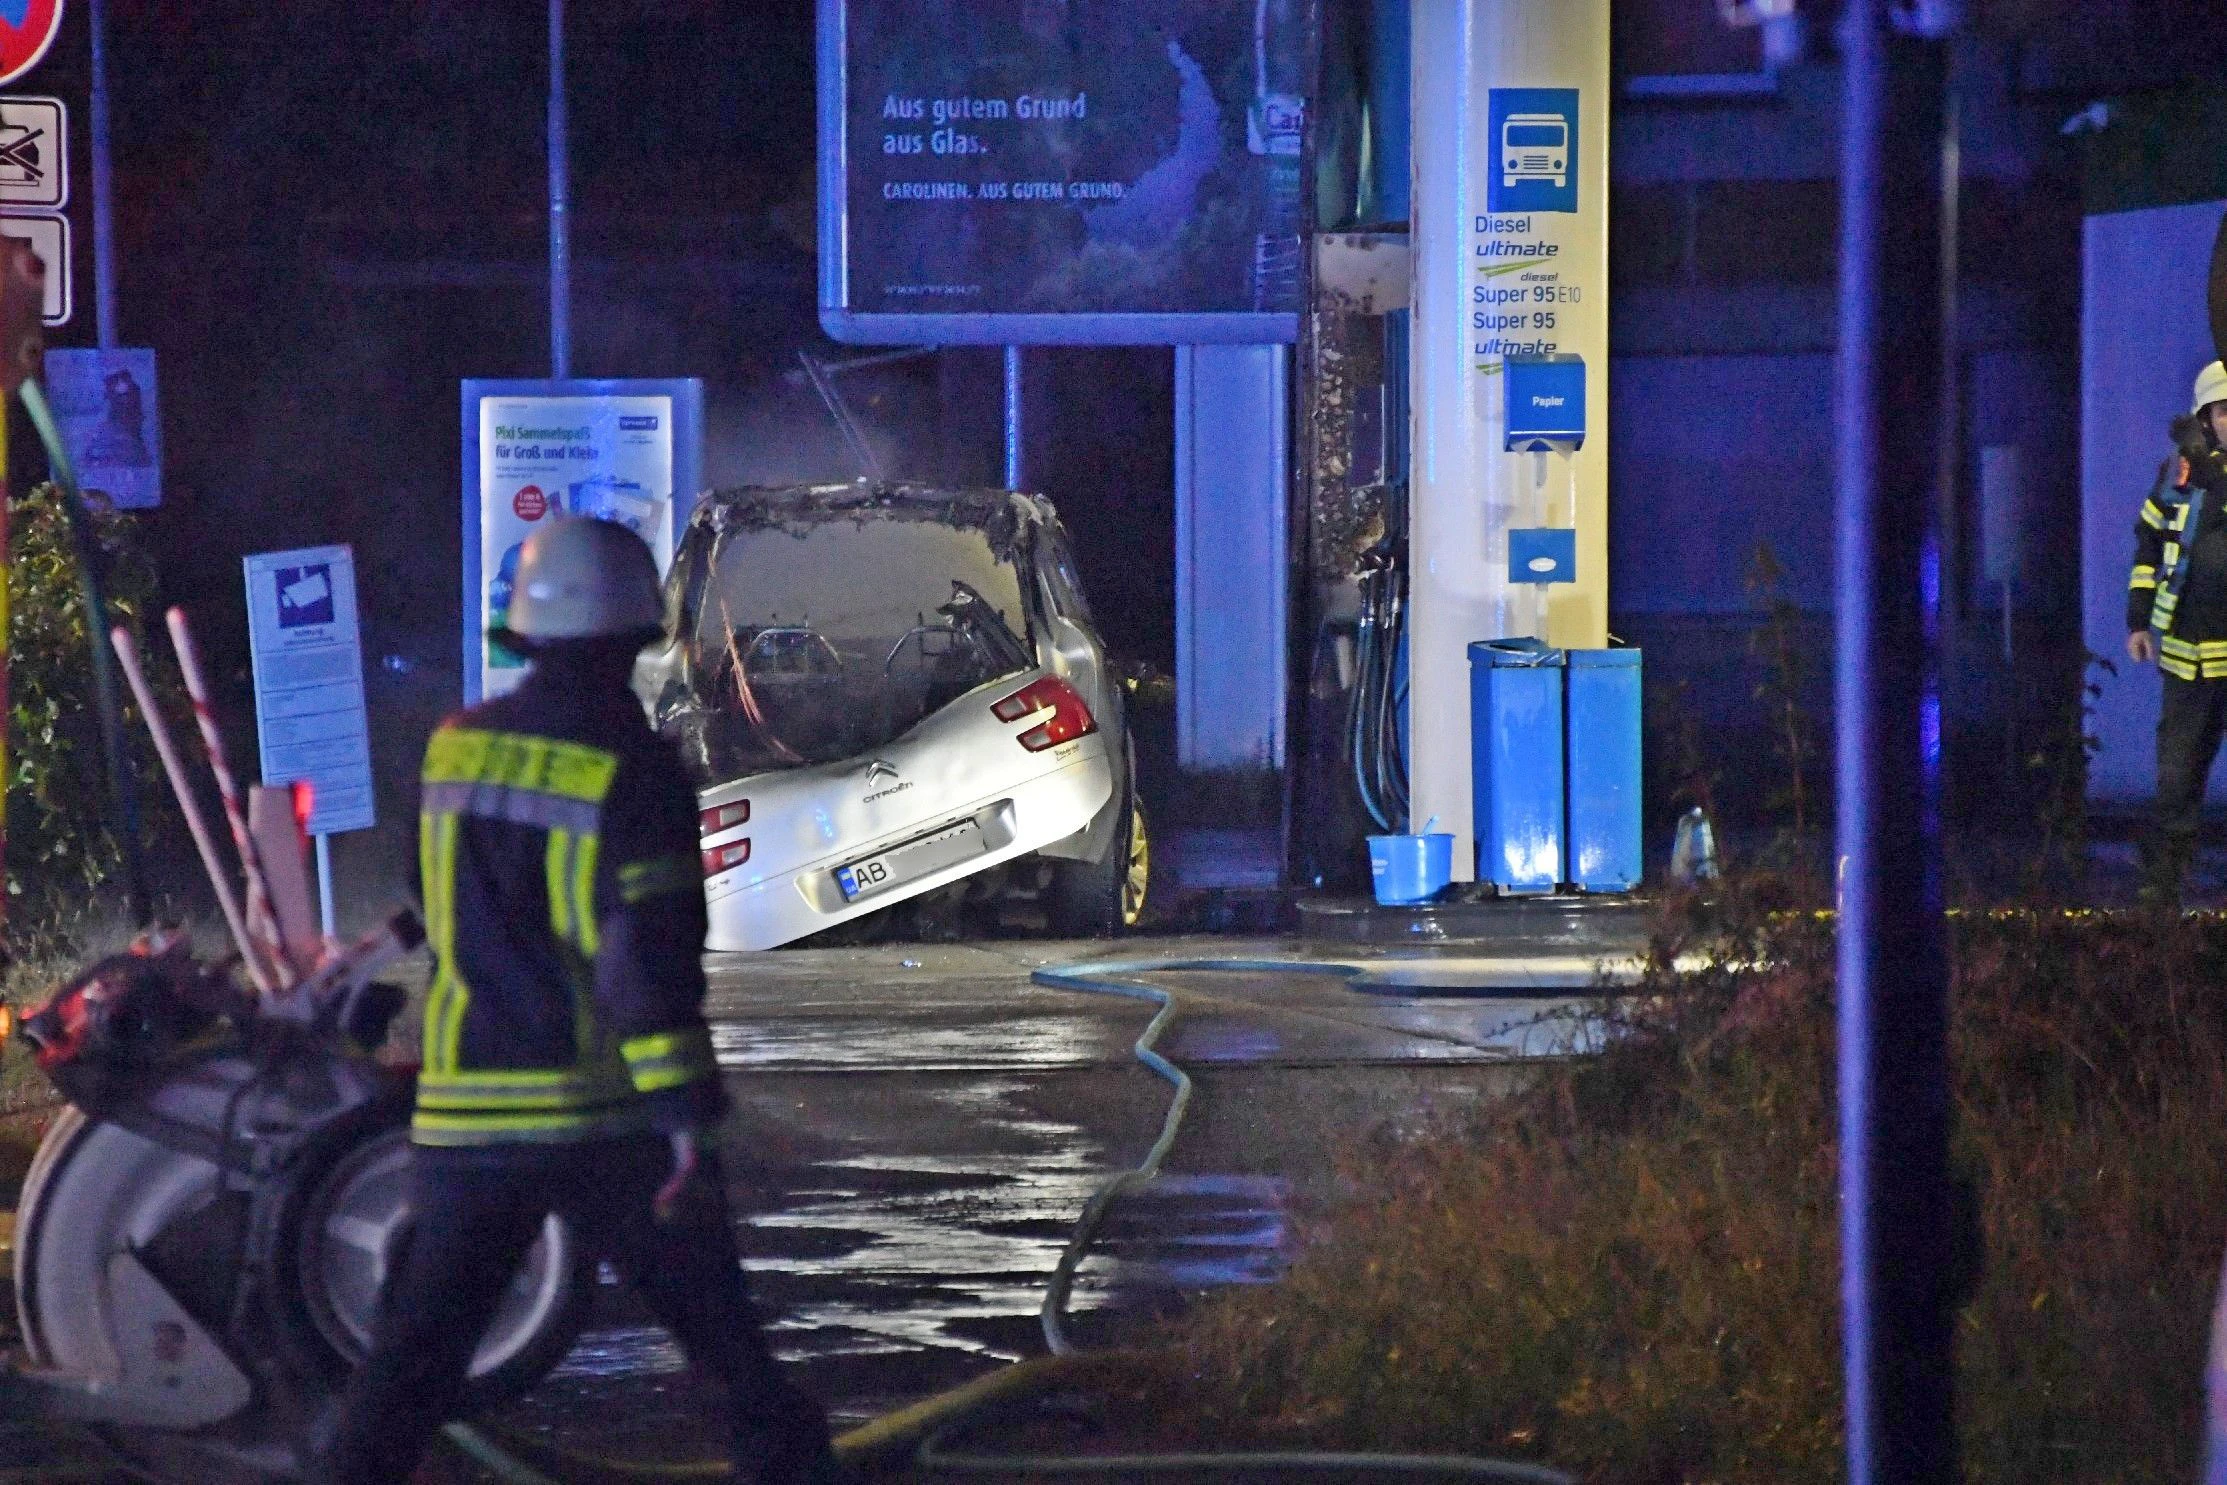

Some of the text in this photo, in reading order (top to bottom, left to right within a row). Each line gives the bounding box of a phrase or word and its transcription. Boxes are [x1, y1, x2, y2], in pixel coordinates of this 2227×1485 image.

[883, 91, 1087, 125] Aus gutem Grund
[883, 127, 988, 154] aus Glas.
[978, 182, 1007, 200] AUS
[1011, 182, 1063, 200] GUTEM
[1475, 215, 1531, 233] Diesel
[1476, 240, 1559, 257] ultimate
[1520, 272, 1558, 282] diesel
[1473, 285, 1581, 306] Super 95 E10
[1473, 311, 1555, 332] Super 95
[1475, 339, 1557, 355] ultimate
[1532, 396, 1565, 408] Papier
[495, 444, 511, 459] für
[514, 445, 541, 460] Groß
[544, 445, 566, 460] und
[856, 861, 887, 889] AB
